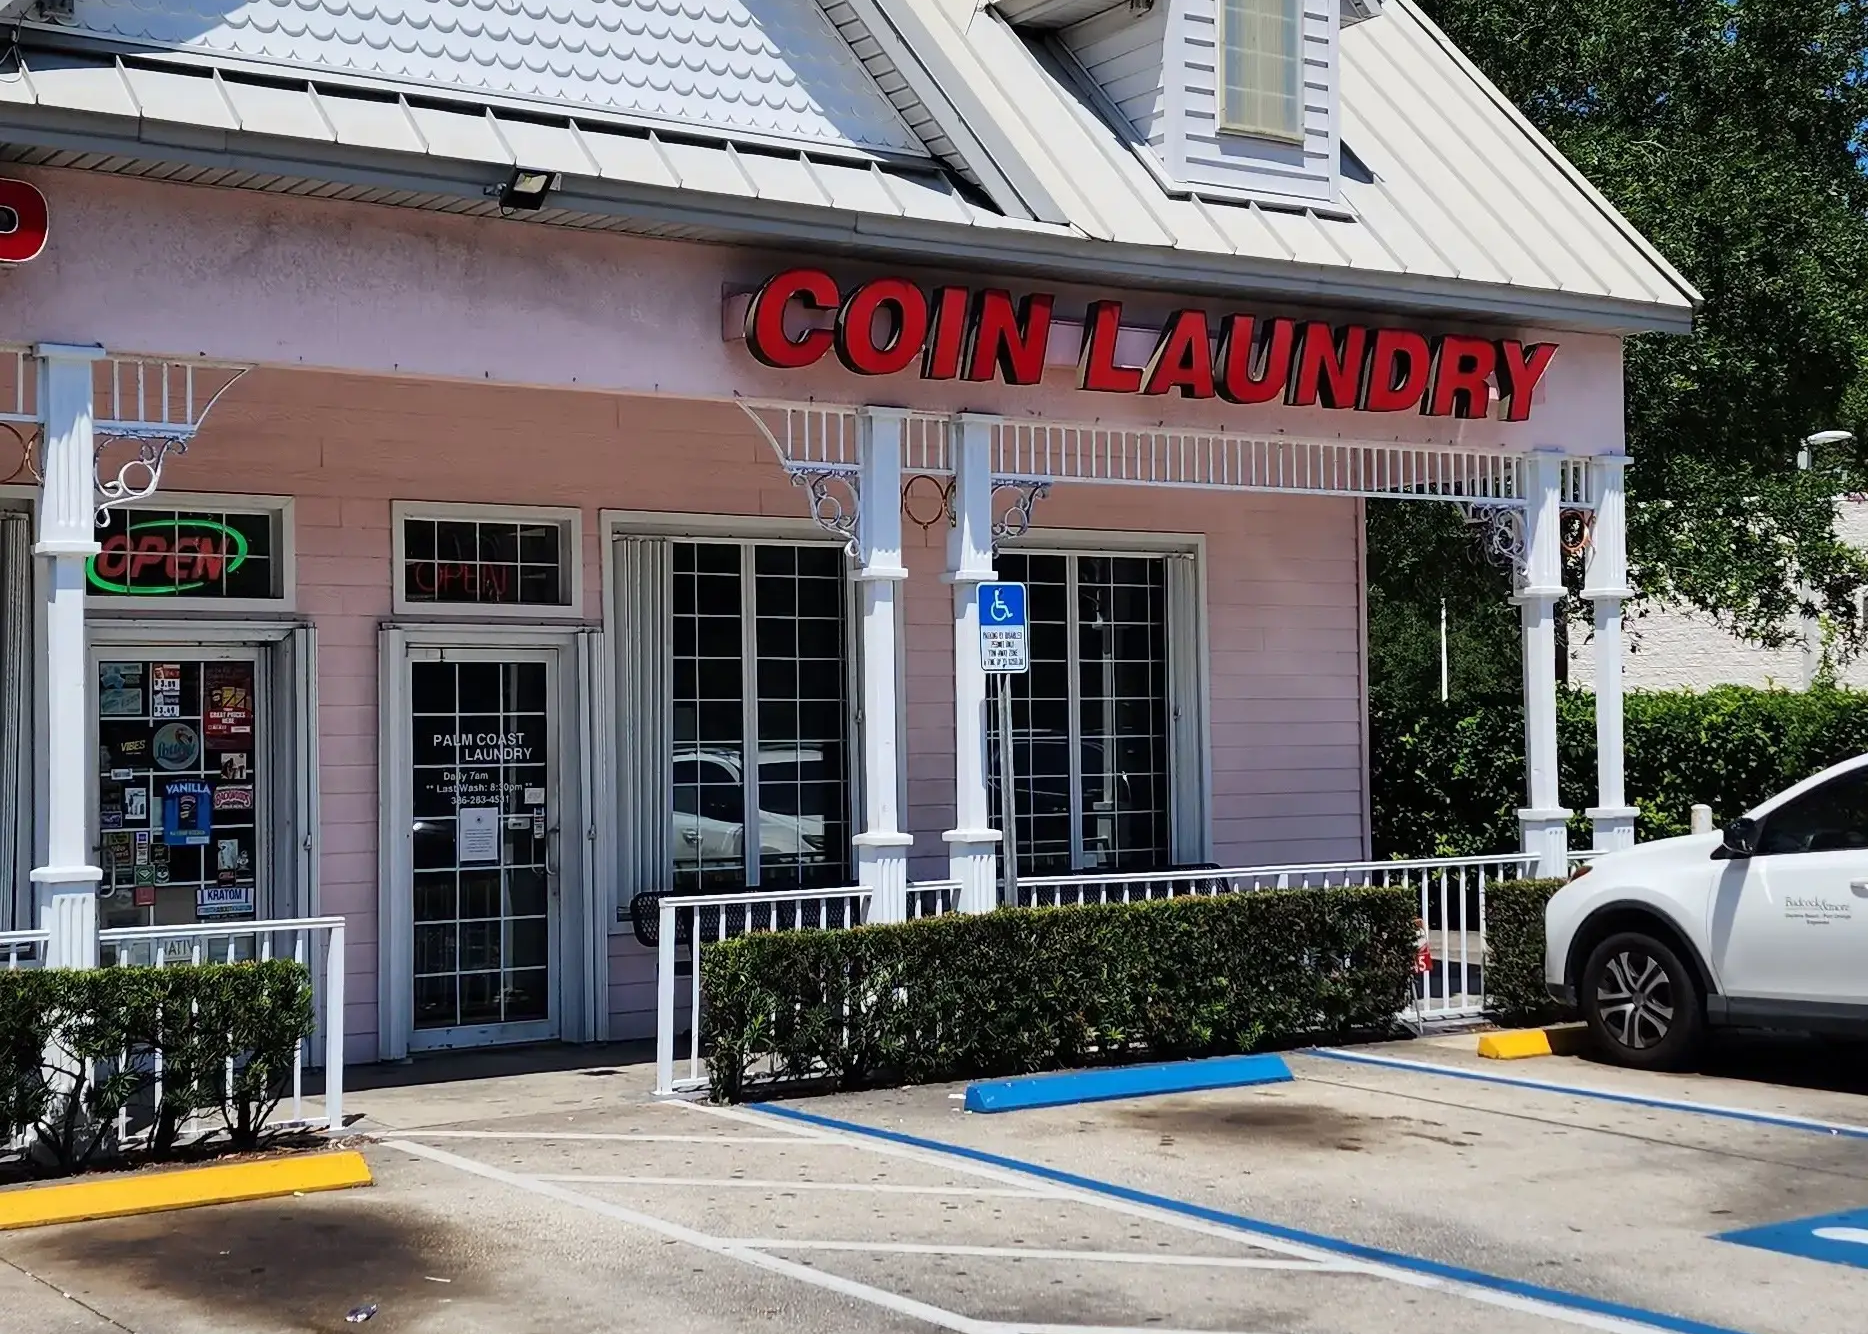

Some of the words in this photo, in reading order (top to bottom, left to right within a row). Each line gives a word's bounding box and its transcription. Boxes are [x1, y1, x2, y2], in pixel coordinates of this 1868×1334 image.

[745, 268, 1054, 385] COIN
[1078, 299, 1559, 422] LAUNDRY
[97, 534, 231, 581] OPEN
[415, 560, 508, 595] OPEN
[121, 740, 146, 752] VIBES
[433, 733, 473, 747] PALM
[476, 732, 525, 746] COAST
[465, 747, 533, 761] LAUNDRY
[443, 772, 467, 782] Daily
[470, 771, 489, 780] 7am
[165, 783, 211, 795] VANILLA
[459, 783, 488, 792] Wash:
[490, 782, 523, 795] 8:30pm
[207, 889, 242, 901] KRATOM
